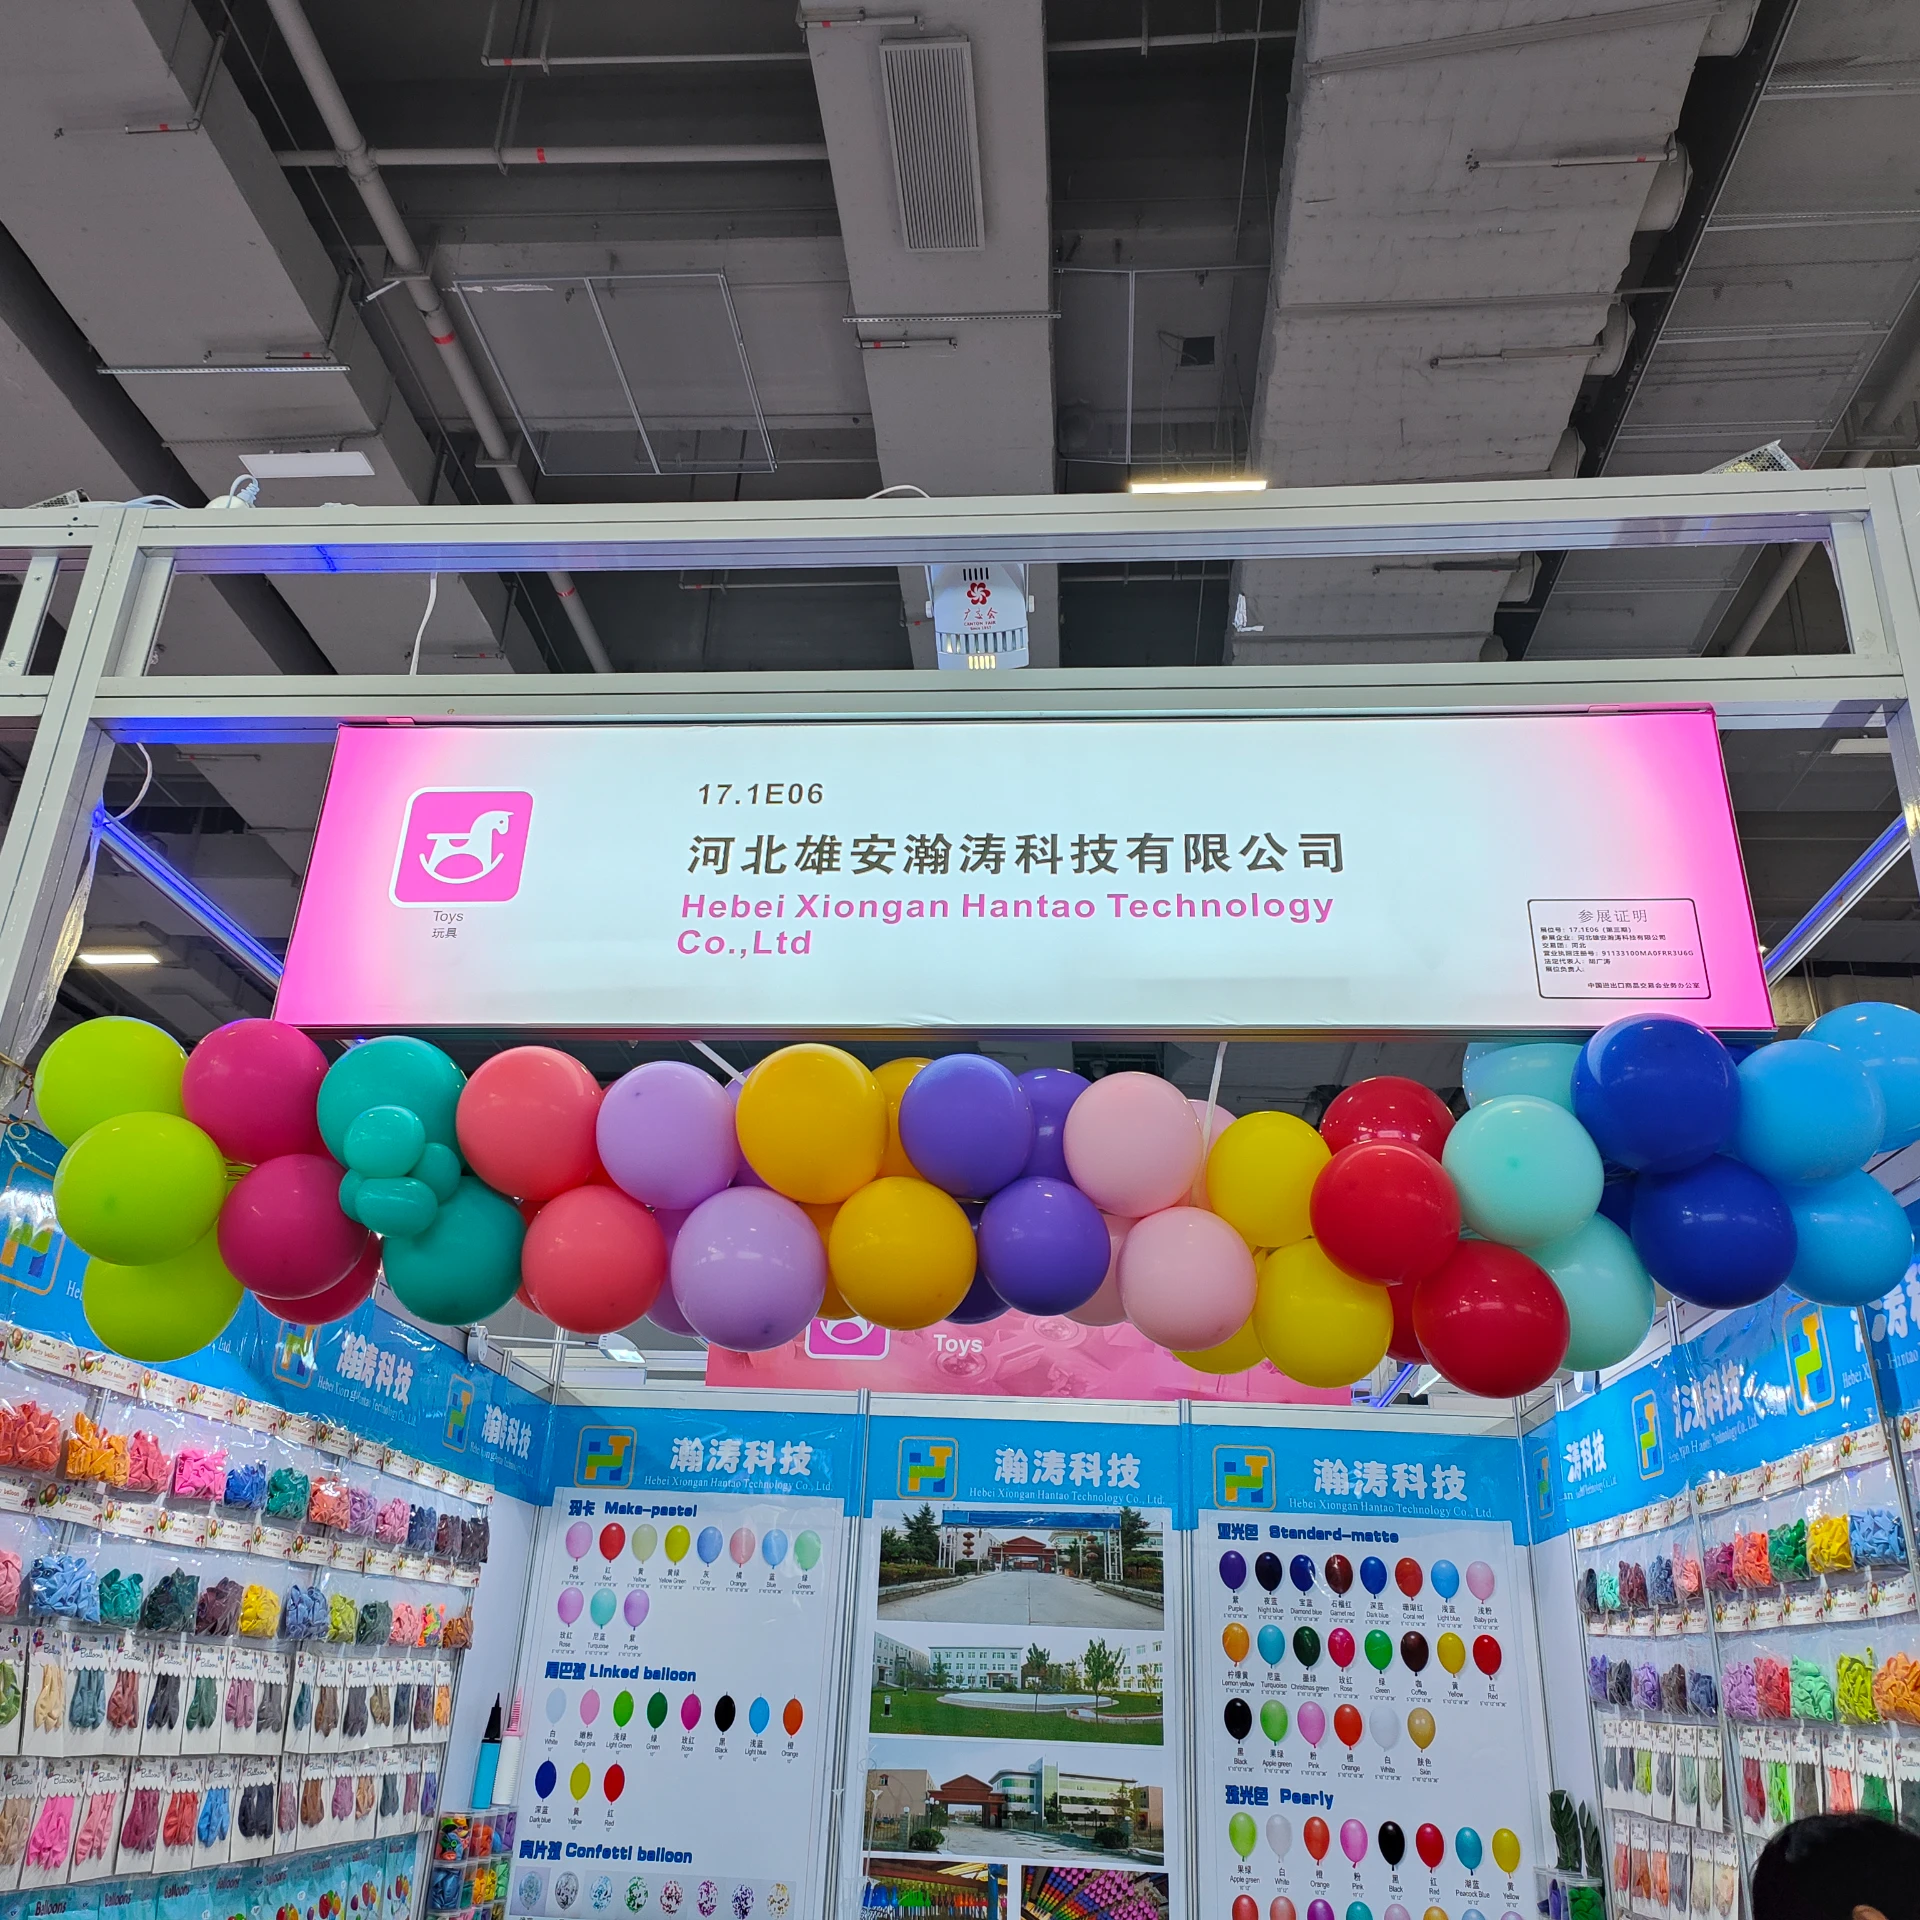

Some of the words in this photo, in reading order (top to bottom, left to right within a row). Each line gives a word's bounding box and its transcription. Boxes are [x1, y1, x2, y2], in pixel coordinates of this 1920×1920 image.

[697, 783, 825, 806] 17.1E06
[686, 831, 1346, 876] 河北雄安瀚涛科技有限公司
[681, 893, 786, 919] Hebei
[795, 893, 949, 926] Xiongan
[961, 892, 1097, 919] Hantao
[1106, 891, 1334, 925] Technology
[433, 910, 464, 925] Toys
[1577, 908, 1648, 923] 参展证明
[431, 927, 458, 939] 玩具
[676, 928, 813, 959] Co.,Ltd
[933, 1333, 983, 1357] Toys
[669, 1437, 814, 1476] 瀚涛科技
[994, 1448, 1141, 1489] 瀚涛科技
[644, 1475, 670, 1486] Hebei
[671, 1477, 708, 1489] Xiongan
[710, 1477, 742, 1488] Hantao
[742, 1478, 794, 1492] Technology
[815, 1481, 833, 1491] Ltd.
[1313, 1458, 1468, 1502] 瀚涛科技
[969, 1487, 995, 1498] Hebei
[997, 1488, 1035, 1500] Xiongan
[1037, 1489, 1069, 1500] Hantao
[1071, 1490, 1124, 1504] Technology
[1147, 1494, 1165, 1505] Ltd.
[1289, 1497, 1316, 1509] Hebei
[1318, 1499, 1359, 1513] Xiongan
[1360, 1501, 1394, 1513] Hantao
[1395, 1503, 1451, 1517] Technology
[1475, 1507, 1495, 1519] Ltd.
[1269, 1525, 1399, 1544] Standard-matte
[1227, 1605, 1244, 1613] Purple
[1257, 1606, 1271, 1614] Night
[1474, 1616, 1487, 1624] Baby
[1487, 1616, 1498, 1624] pink
[589, 1663, 640, 1680] Linked
[643, 1666, 697, 1682] balloon
[1239, 1680, 1255, 1688] yellow
[1260, 1681, 1288, 1690] Turquoise
[1290, 1683, 1315, 1691] Christmas
[1374, 1686, 1391, 1694] Green
[1447, 1690, 1464, 1698] Yellow
[1487, 1692, 1499, 1700] Red
[544, 1738, 559, 1746] White
[574, 1739, 586, 1747] Baby
[586, 1740, 597, 1748] pink
[606, 1741, 617, 1749] Light
[744, 1748, 757, 1756] Light
[781, 1750, 799, 1758] Orange
[1233, 1757, 1248, 1765] Black
[1262, 1759, 1277, 1768] Apple
[1277, 1761, 1293, 1769] green
[1307, 1761, 1320, 1769] Pink
[1340, 1764, 1361, 1773] Orange
[1380, 1766, 1396, 1774] White
[1419, 1768, 1431, 1776] Skin
[1279, 1788, 1334, 1810] Pearly
[528, 1815, 541, 1823] Dark
[541, 1816, 552, 1824] blue
[567, 1817, 583, 1825] Yellow
[604, 1819, 615, 1827] Red
[565, 1842, 633, 1861] Confetti
[637, 1846, 693, 1864] balloon
[1229, 1875, 1245, 1884] Apple
[1245, 1876, 1261, 1884] green
[1274, 1877, 1290, 1886] White
[1309, 1880, 1330, 1889] Orange
[1388, 1885, 1404, 1893] Black
[163, 1882, 191, 1899] Balloons
[1428, 1887, 1440, 1895] Red
[1455, 1889, 1478, 1898] Peacock
[1478, 1890, 1491, 1899] Blue
[104, 1889, 131, 1908] Balloons
[1502, 1892, 1520, 1901] Yellow
[34, 1900, 67, 1917] Balloons
